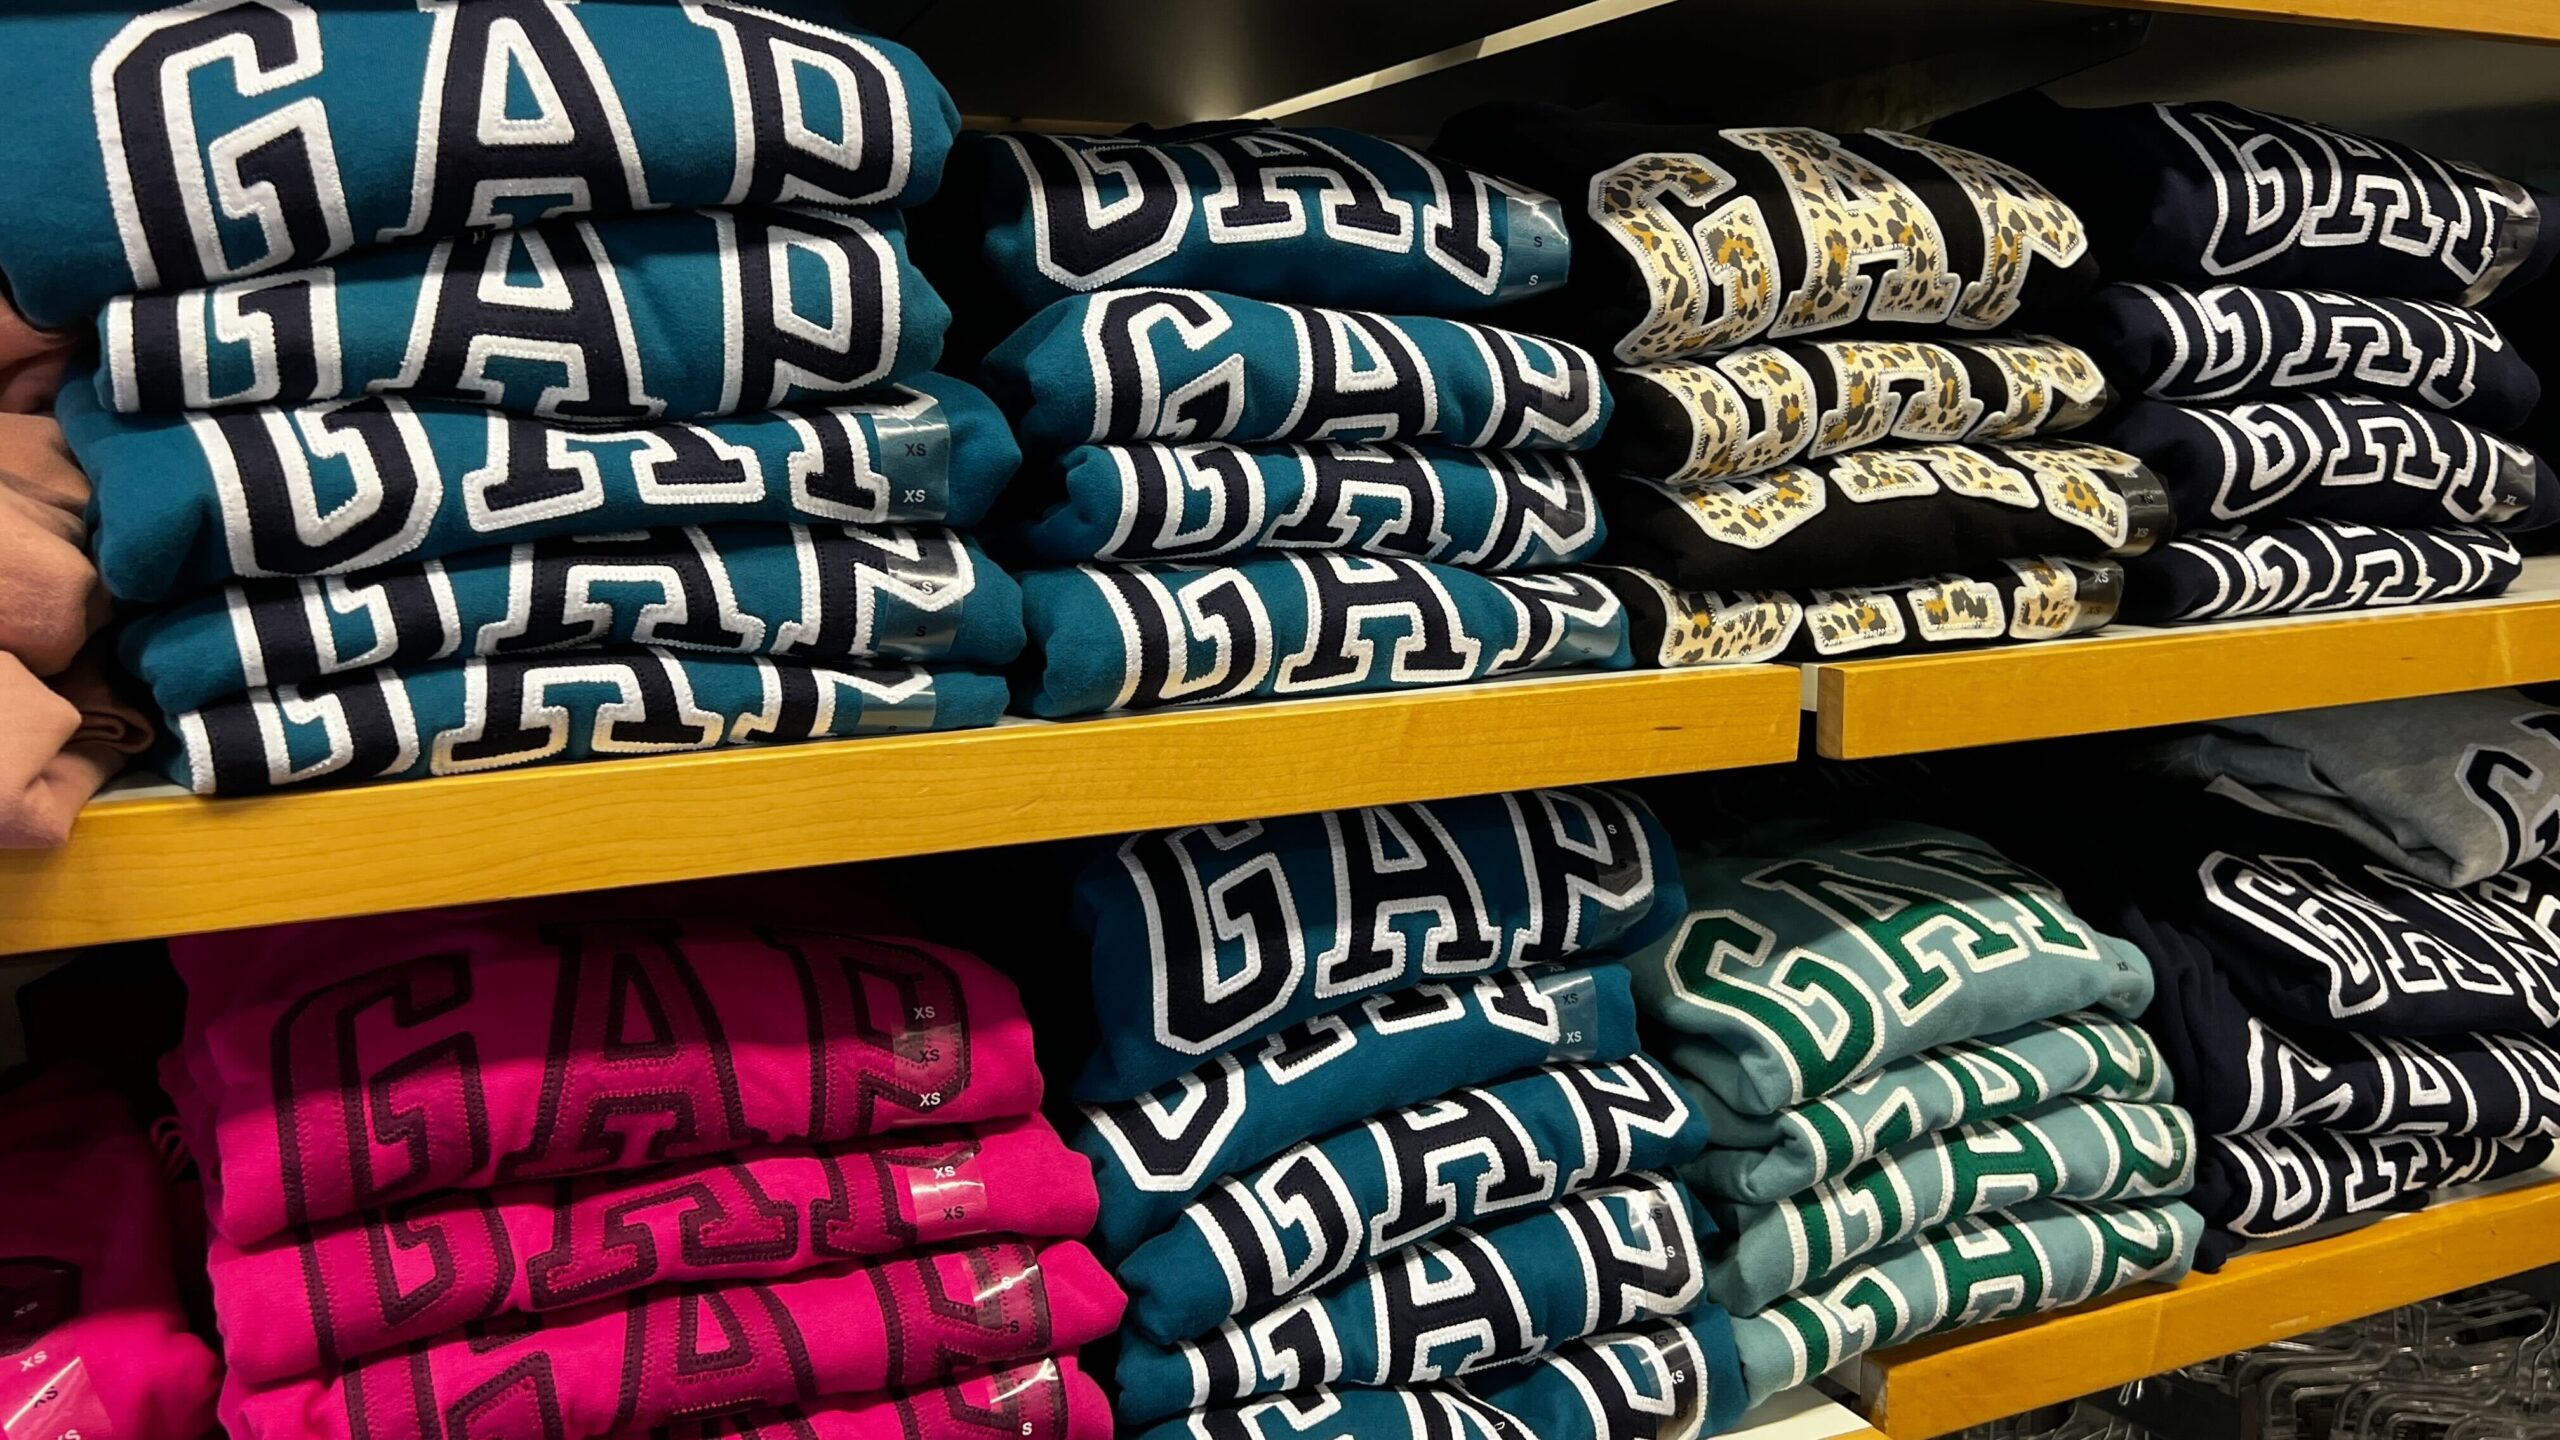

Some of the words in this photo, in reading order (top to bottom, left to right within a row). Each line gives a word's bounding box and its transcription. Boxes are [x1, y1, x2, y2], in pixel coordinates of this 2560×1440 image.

[91, 0, 916, 290] GAP
[1533, 236, 1543, 248] S
[1588, 126, 2088, 366] GAP
[1528, 274, 1539, 286] S
[904, 443, 927, 457] XS
[903, 489, 926, 503] XS
[2094, 571, 2110, 584] XS
[921, 581, 934, 594] S
[915, 625, 927, 637] S
[1607, 824, 1618, 835] S
[1117, 784, 1656, 1055] GAP
[1664, 840, 2100, 1100] GAP
[2116, 961, 2129, 972] XS
[1562, 992, 1579, 1005] XS
[913, 1006, 936, 1020] XS
[1566, 1030, 1582, 1044] XS
[919, 1048, 940, 1063] XS
[271, 916, 972, 1228] GAP
[919, 1091, 941, 1107] XS
[933, 1165, 956, 1179] XS
[942, 1206, 965, 1221] XS
[1661, 1245, 1676, 1258] S
[1009, 1320, 1020, 1334] S
[20, 1350, 48, 1373] XS
[1021, 1421, 1033, 1436] S
